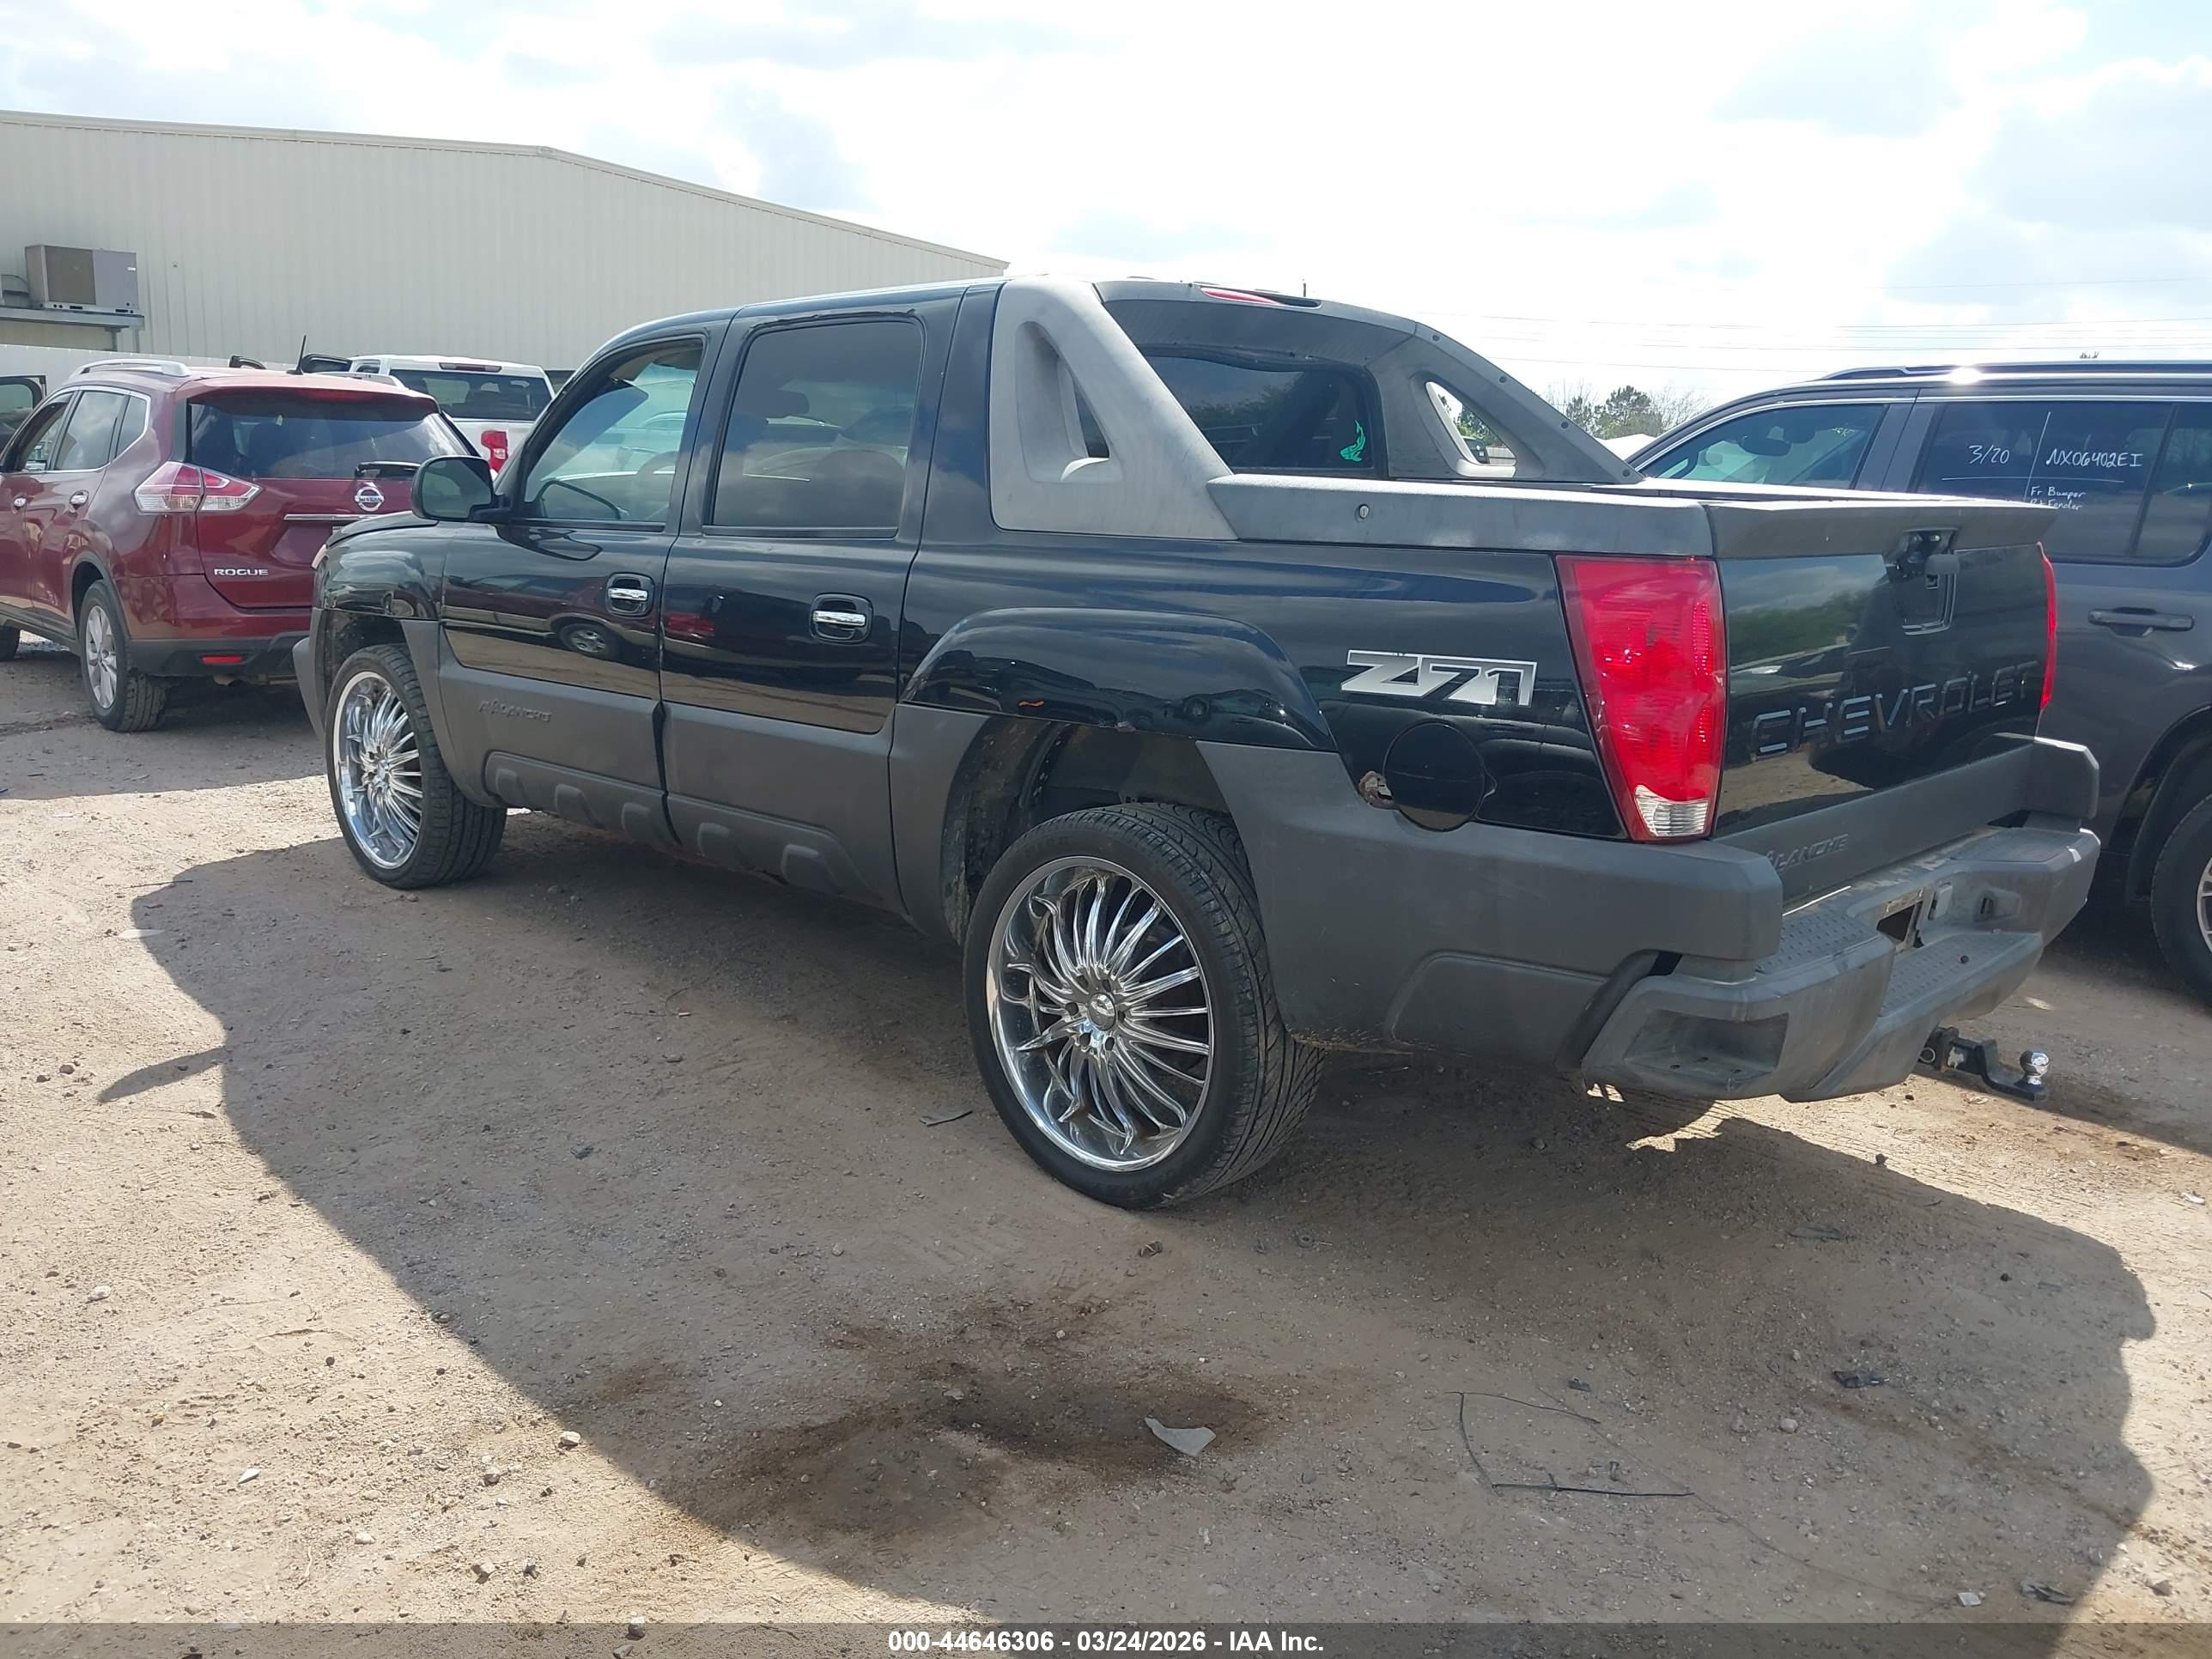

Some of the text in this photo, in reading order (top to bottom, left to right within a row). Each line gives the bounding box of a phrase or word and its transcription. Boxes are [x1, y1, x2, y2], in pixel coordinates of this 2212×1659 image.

[1968, 445, 2009, 465] 3/20
[2030, 485, 2044, 496] Fr
[1340, 649, 1537, 708] Z71
[1750, 659, 2040, 763] CHEVROLET
